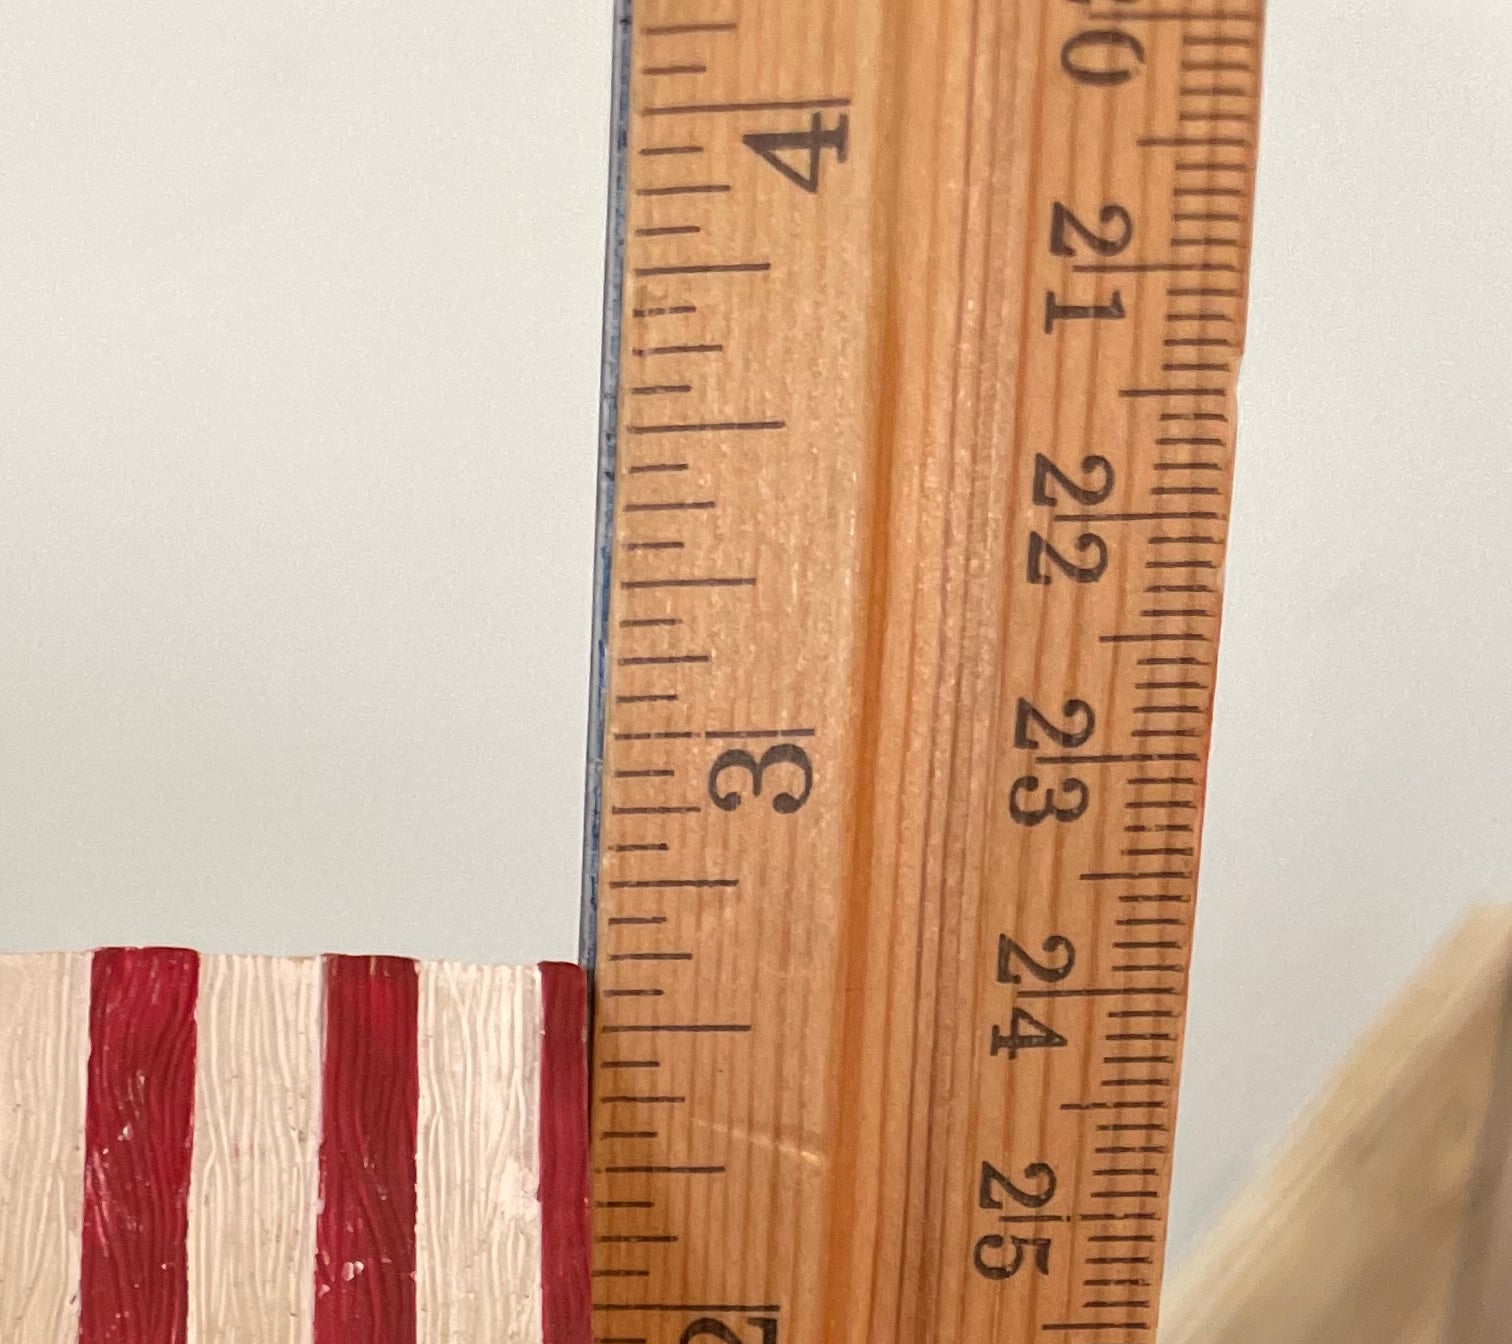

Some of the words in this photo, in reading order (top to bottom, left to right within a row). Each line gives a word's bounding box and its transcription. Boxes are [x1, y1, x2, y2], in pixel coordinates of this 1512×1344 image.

[1060, 0, 1145, 86] 0
[743, 111, 850, 194] 4
[1045, 201, 1134, 334] 21
[1026, 452, 1116, 586] 22
[708, 743, 814, 815] 3
[1008, 697, 1097, 827] 23
[991, 932, 1076, 1061] 24
[973, 1160, 1057, 1280] 25
